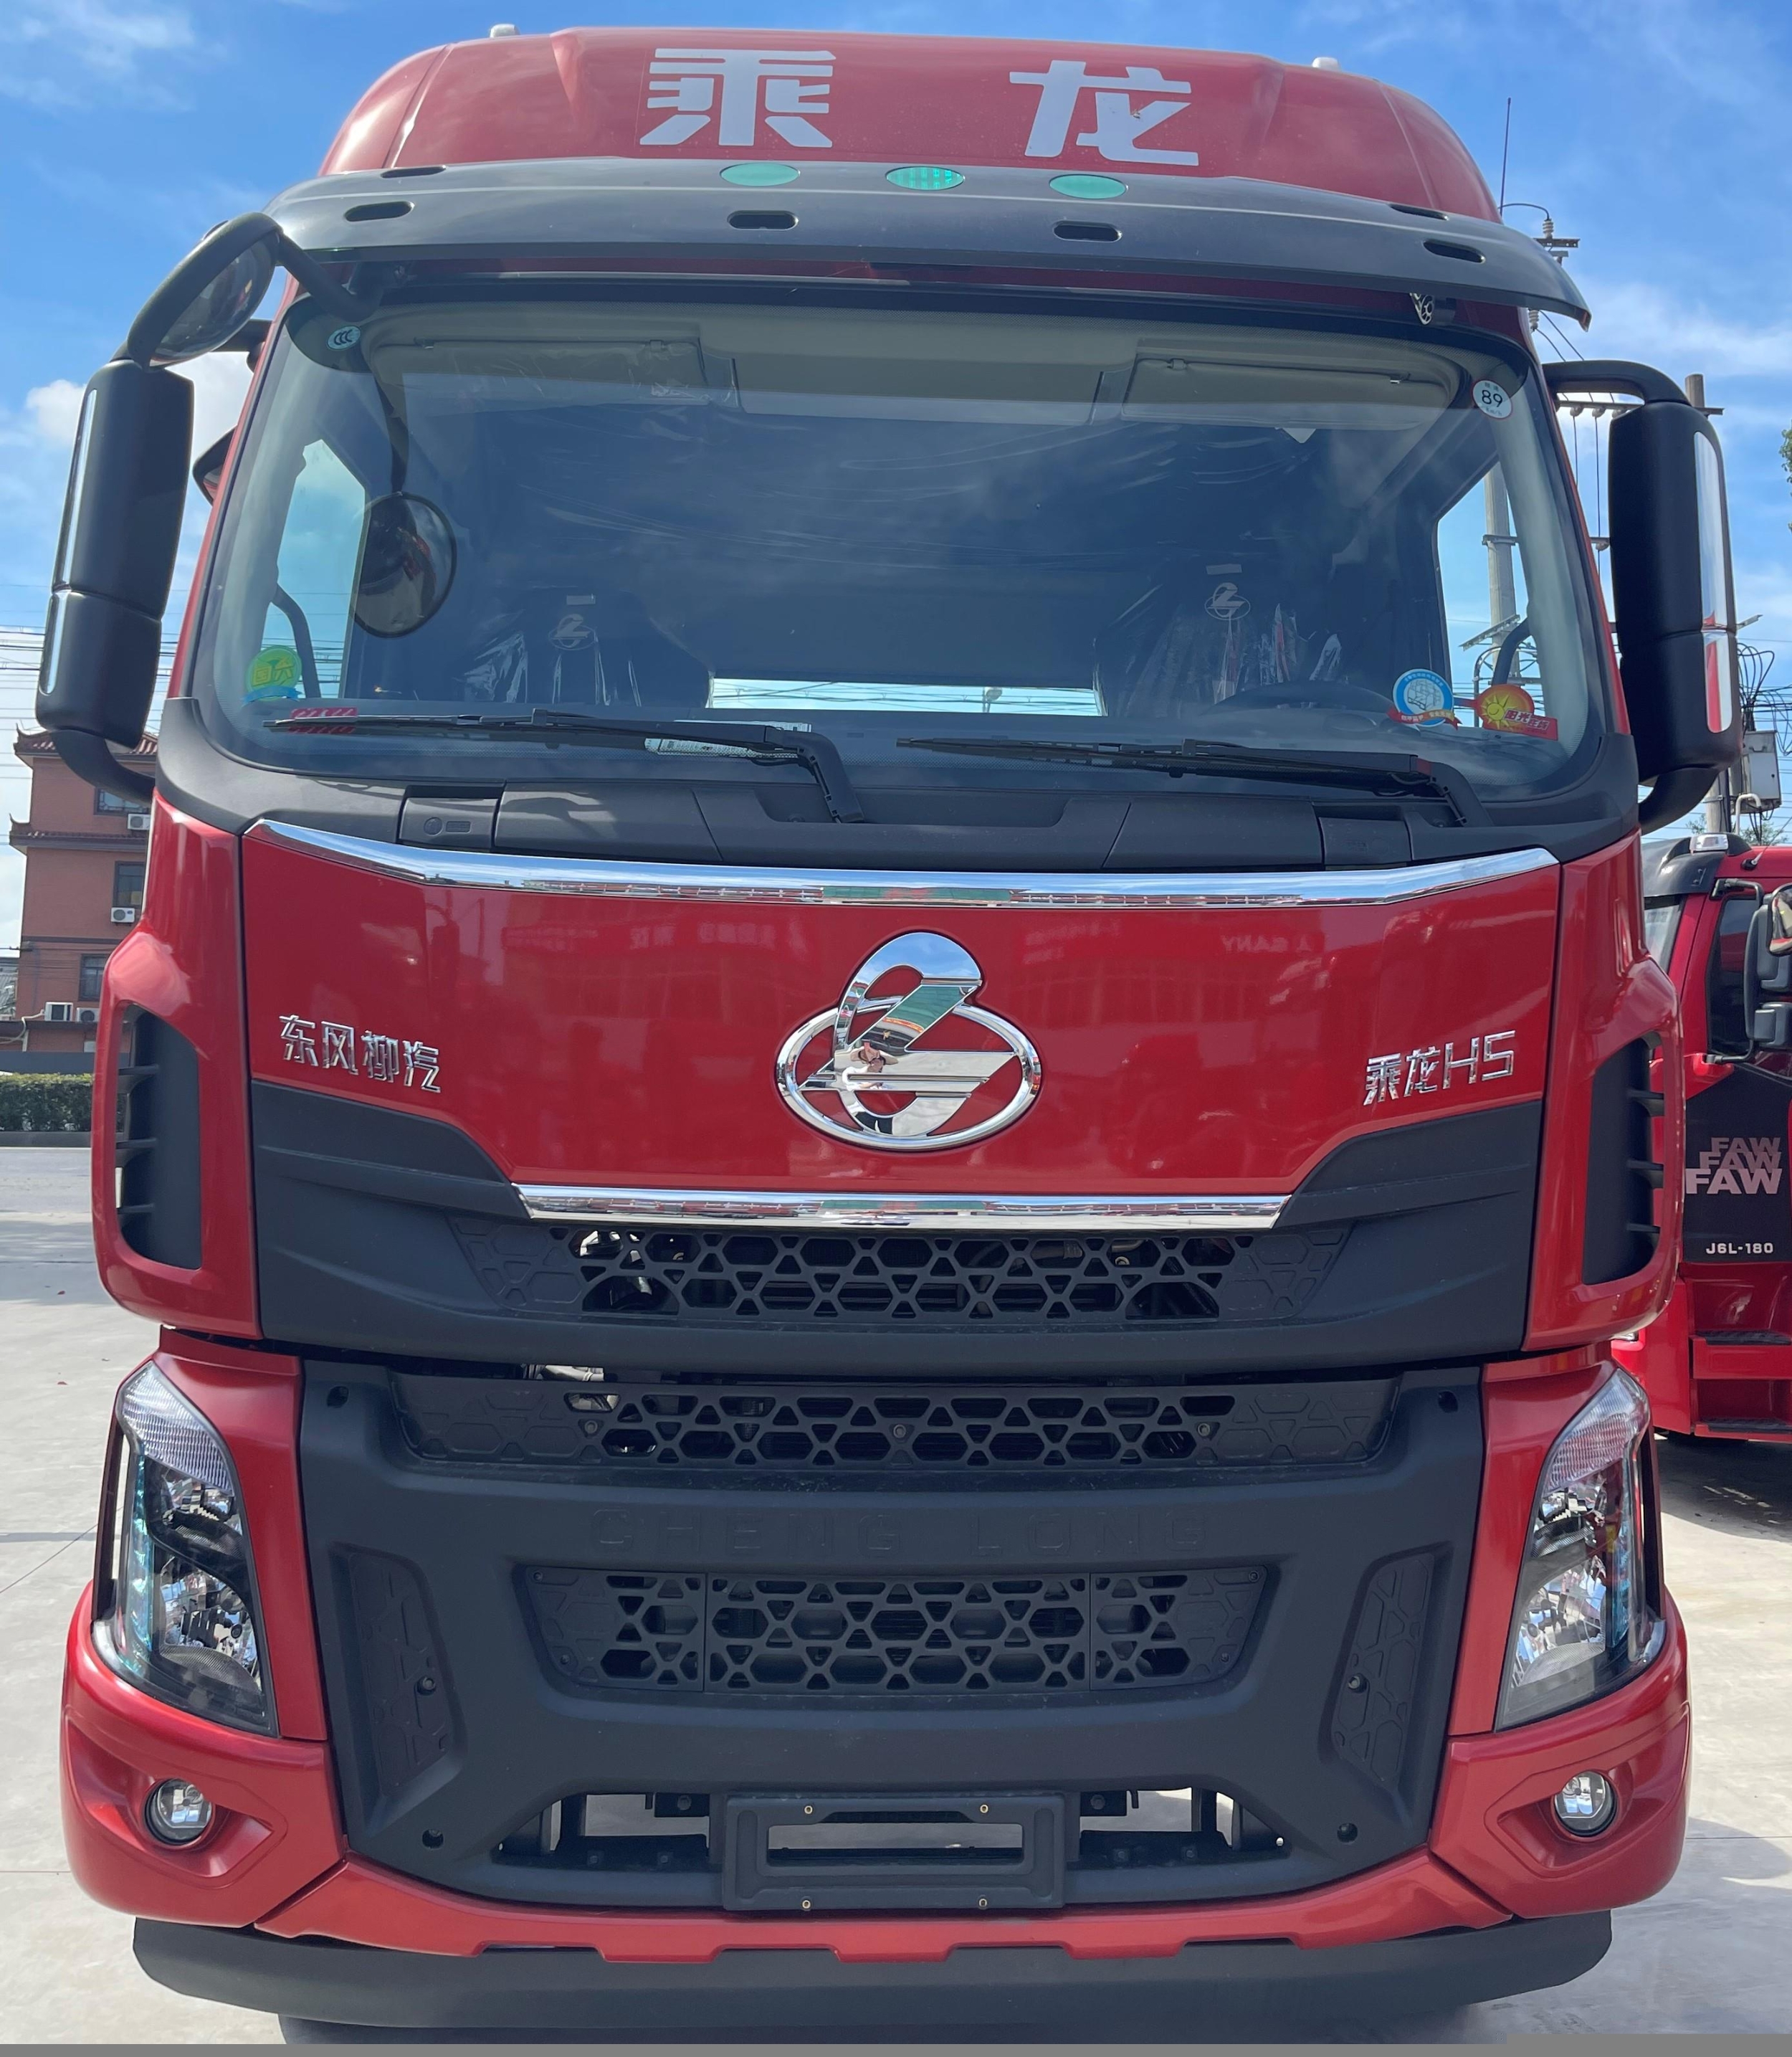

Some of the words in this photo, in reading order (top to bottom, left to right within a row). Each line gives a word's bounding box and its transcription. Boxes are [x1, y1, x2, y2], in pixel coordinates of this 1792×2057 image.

[639, 48, 1198, 166] 乘龙
[1482, 389, 1502, 408] 89
[279, 1014, 442, 1093] 东风柳汽
[1711, 1137, 1781, 1155] FAW
[1699, 1151, 1781, 1174] FAW
[1685, 1168, 1783, 1194] FAW
[1705, 1242, 1774, 1255] J6L-180
[592, 1507, 903, 1558] CHENG
[971, 1509, 1207, 1559] LONG
